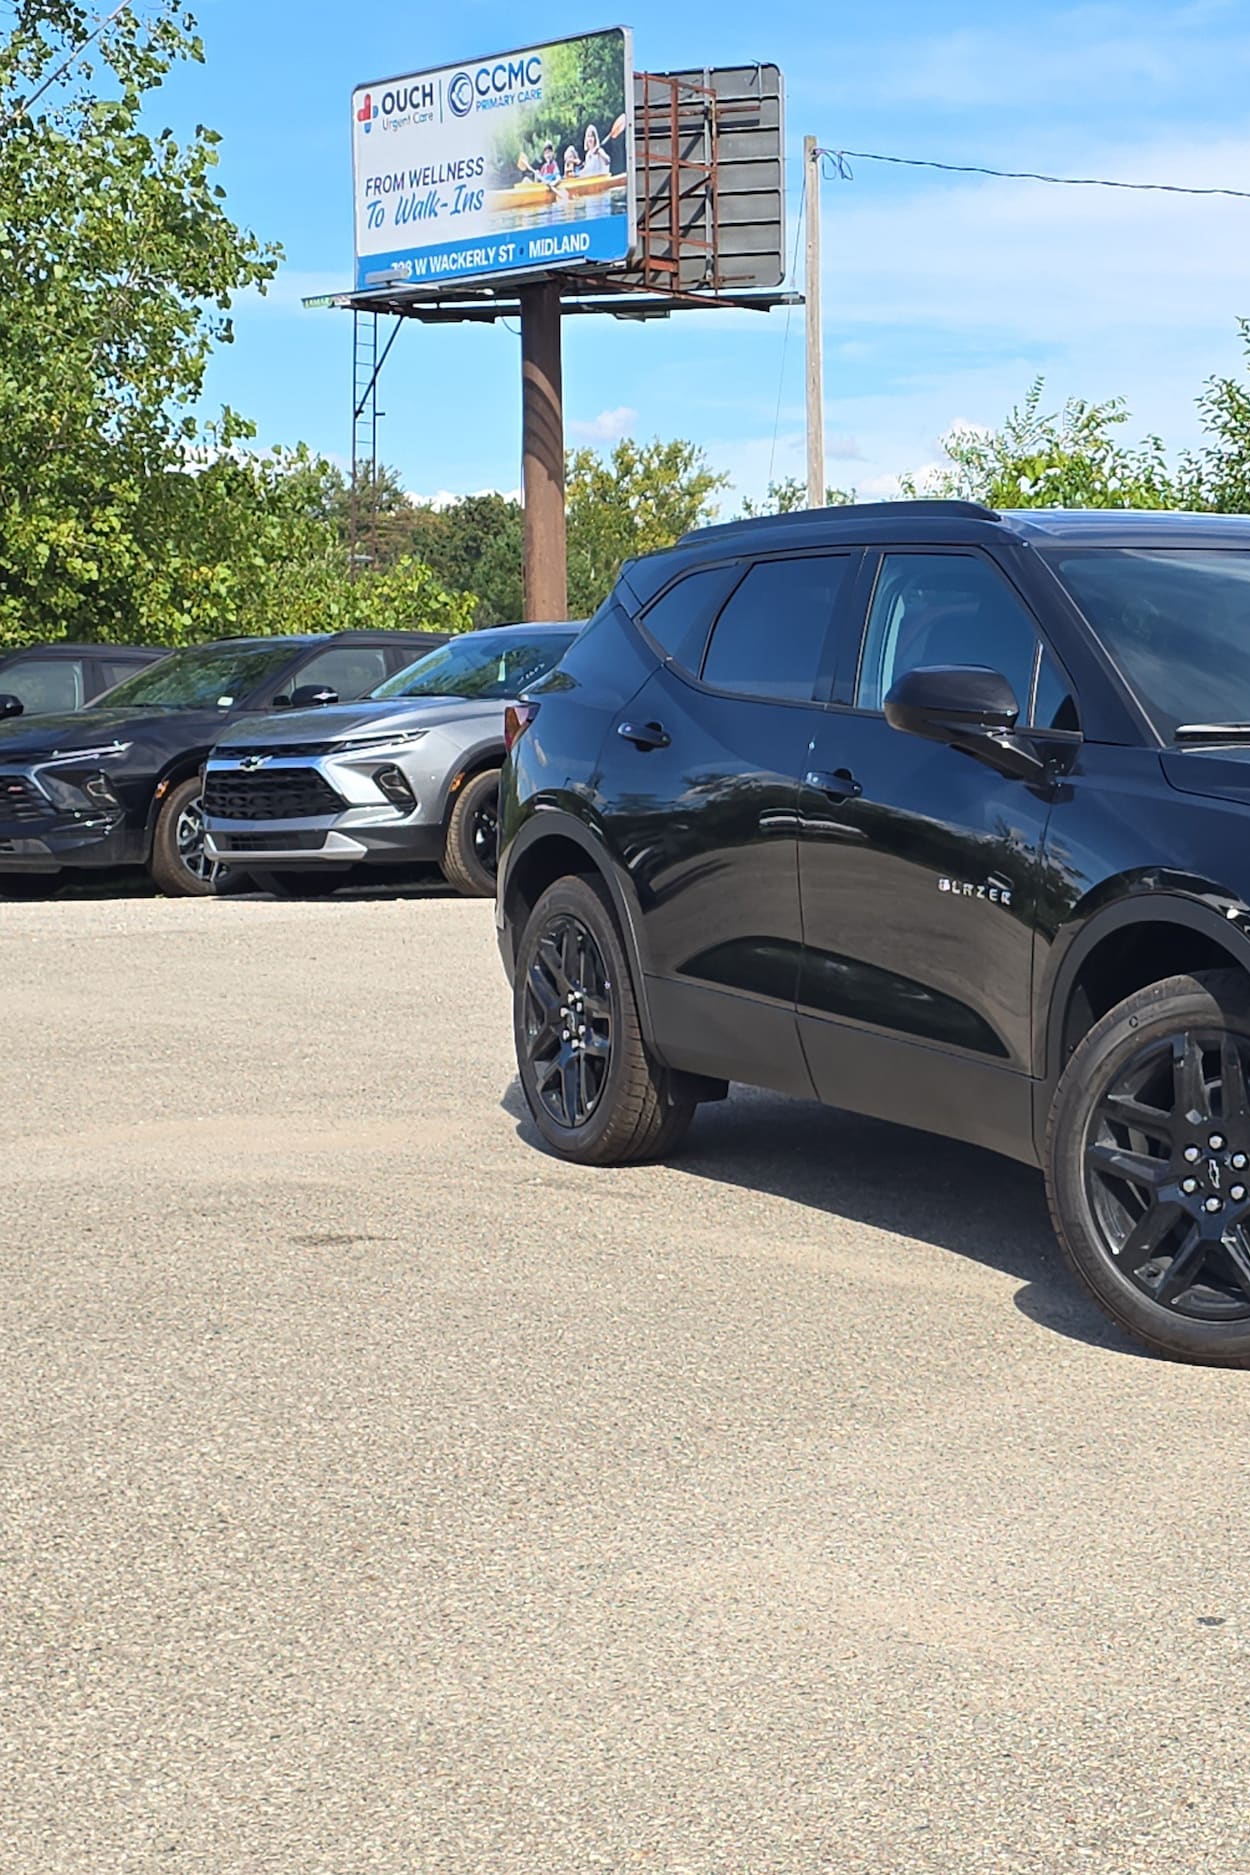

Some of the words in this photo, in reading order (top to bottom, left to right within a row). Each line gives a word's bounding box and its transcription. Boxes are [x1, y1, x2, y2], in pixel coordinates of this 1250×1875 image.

[475, 57, 542, 96] CCMC
[381, 82, 434, 115] OUCH
[475, 93, 516, 112] PRIMARY
[517, 88, 543, 103] CARE
[382, 114, 411, 132] Urgent
[412, 112, 434, 124] Care
[365, 172, 405, 197] FROM
[408, 157, 485, 188] WELLNESS
[366, 200, 385, 230] To
[394, 184, 485, 226] Walk-Ins
[414, 257, 428, 276] W
[429, 247, 497, 274] WACKERLY
[498, 243, 516, 263] ST
[528, 233, 591, 258] MIDLAND
[938, 879, 1012, 905] BLAZER
